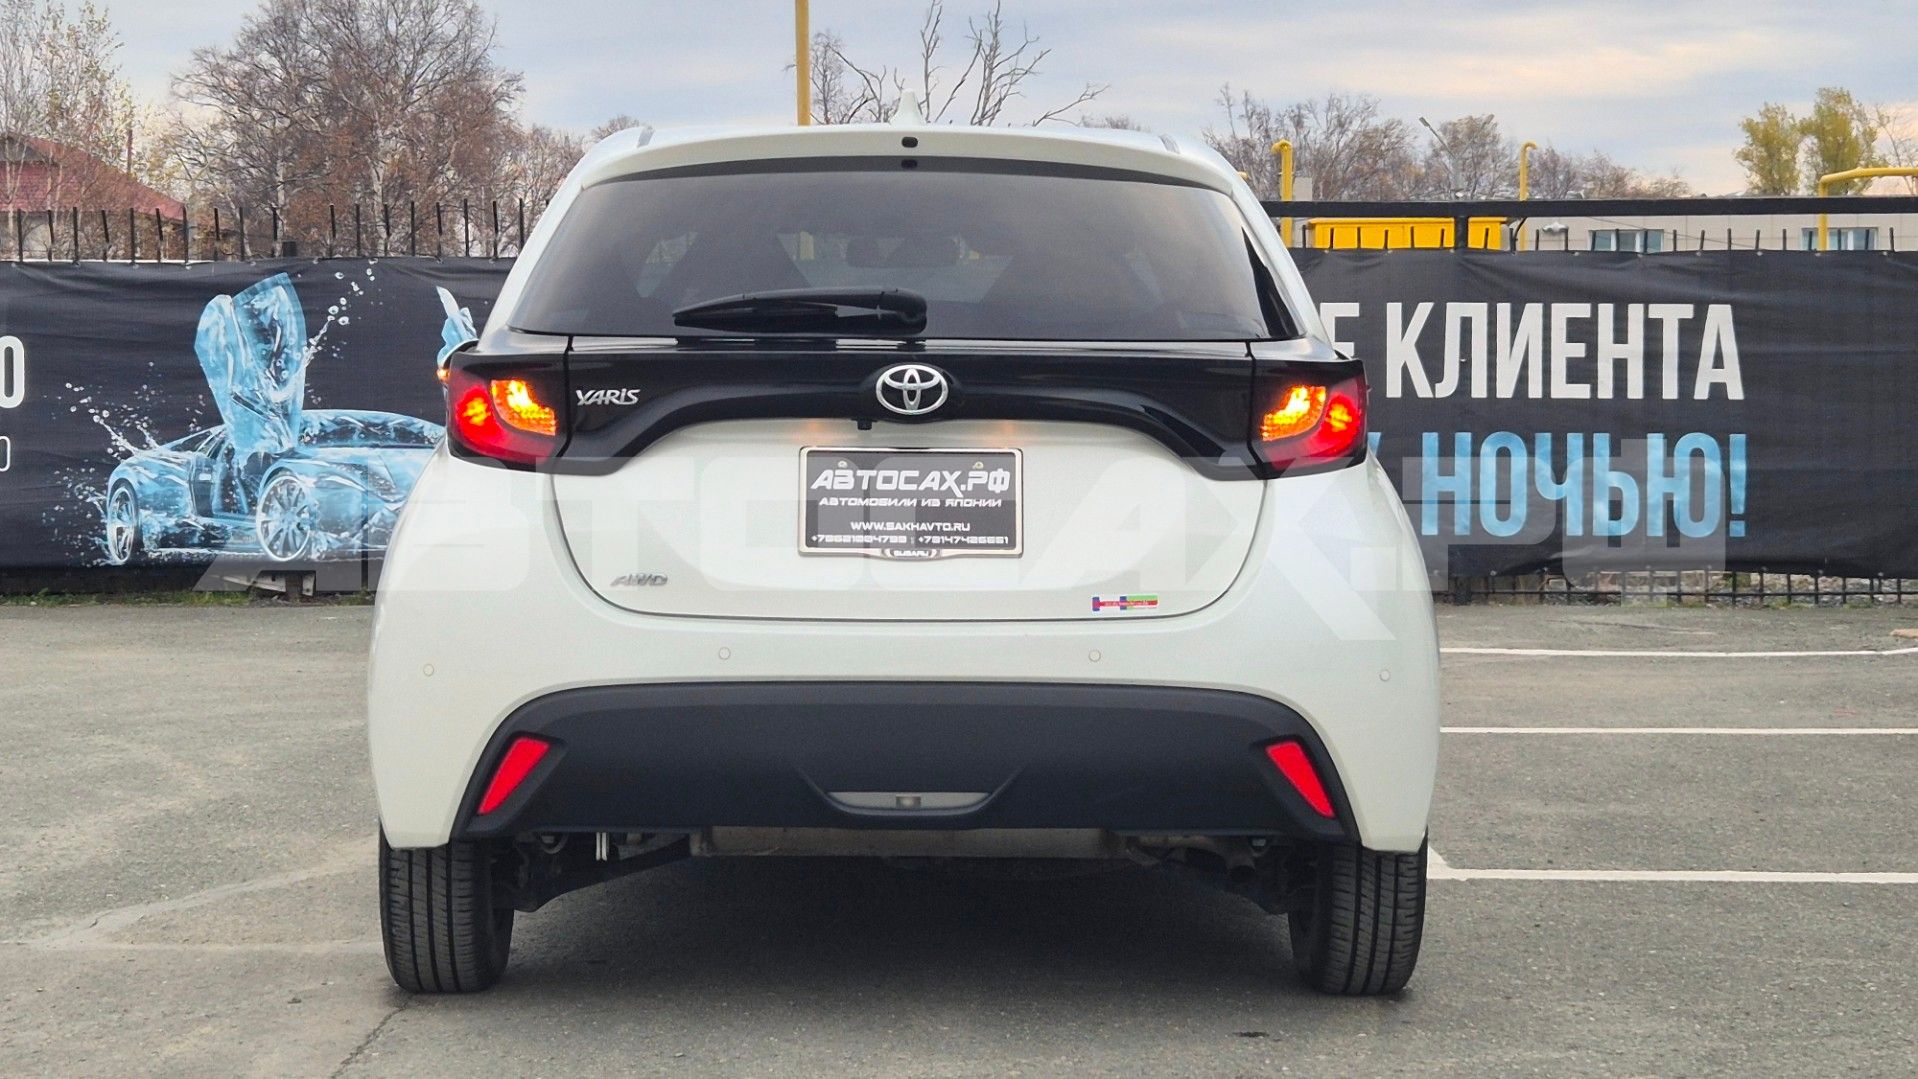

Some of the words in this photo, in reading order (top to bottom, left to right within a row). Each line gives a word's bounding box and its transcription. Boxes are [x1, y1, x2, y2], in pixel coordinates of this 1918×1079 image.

[1386, 302, 1745, 400] КЛИЕНТА
[575, 388, 641, 406] YARIS
[810, 468, 1011, 498] АВТОСАХ.РФ
[1421, 431, 1747, 538] НОЧЬЮ!
[818, 497, 917, 507] АВТОМОБИЛИ
[921, 498, 940, 507] ИЗ
[945, 498, 1001, 508] ЯПОНИИ
[610, 574, 668, 586] AWD
